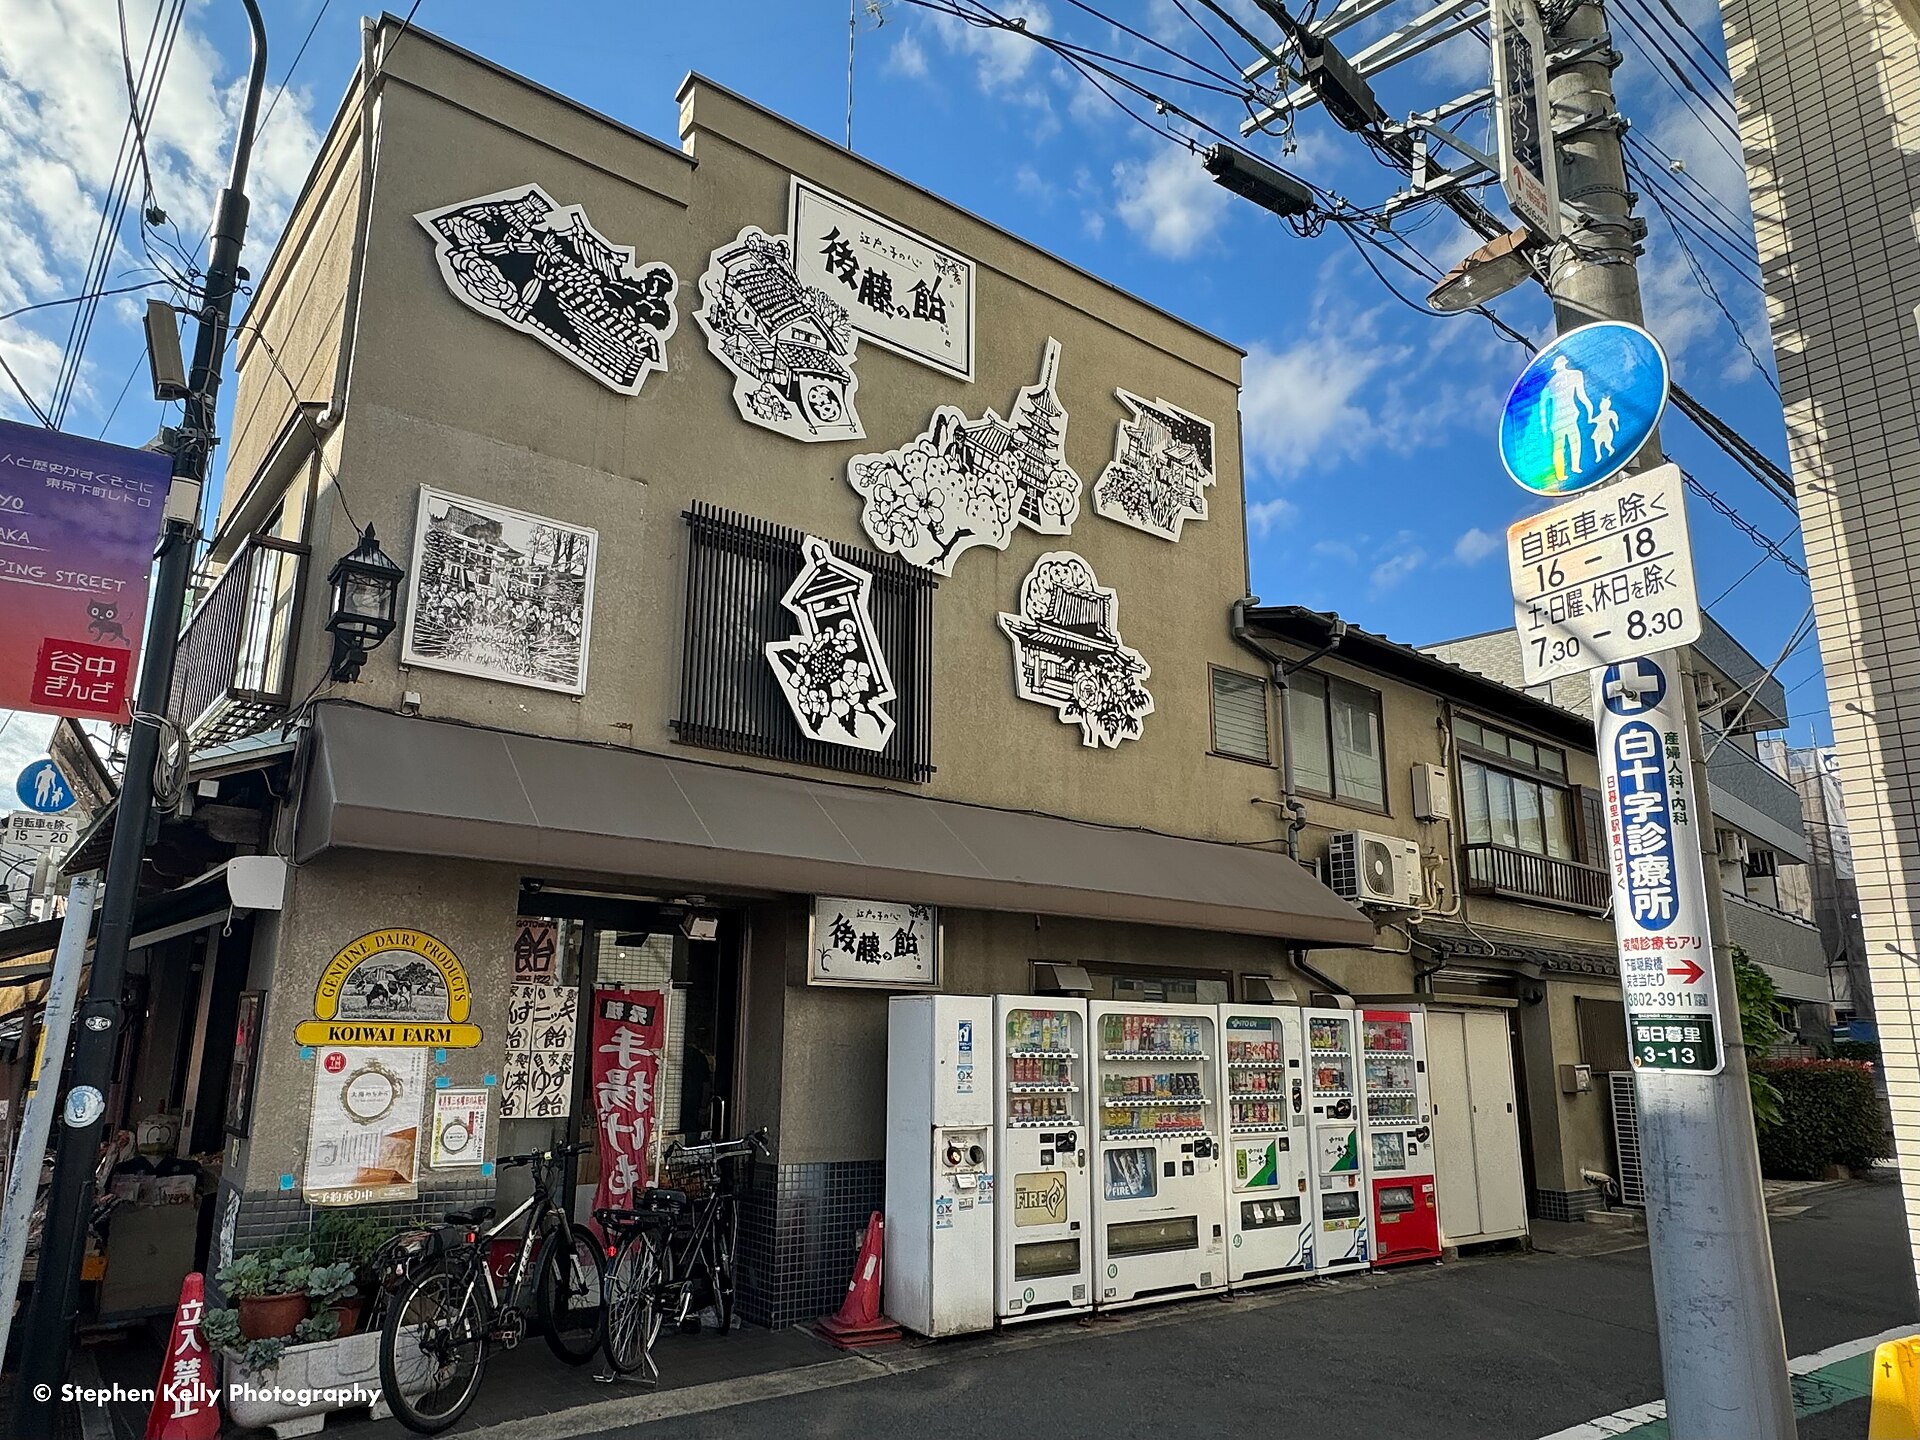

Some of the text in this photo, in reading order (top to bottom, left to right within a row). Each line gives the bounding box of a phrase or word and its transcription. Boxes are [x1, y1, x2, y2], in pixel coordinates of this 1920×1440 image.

[819, 226, 946, 325] 後藤の飴
[45, 477, 151, 508] 東京下町レトロ
[1521, 492, 1667, 561] 自転車を除く
[1537, 558, 1565, 591] 16
[1622, 527, 1656, 563] 18
[55, 570, 127, 593] STREET
[1531, 636, 1580, 668] 7.30
[1627, 608, 1684, 641] 8.30
[50, 651, 116, 677] 谷中
[44, 675, 115, 703] ぎんざ
[1664, 731, 1688, 826] 産婦人科・内科
[13, 817, 73, 831] 自転車を除く
[15, 830, 28, 841] 15
[50, 832, 69, 843] 20
[1607, 776, 1625, 890] 日暮里駅東口すぐ
[1618, 727, 1674, 921] 白十字診療所
[514, 927, 555, 973] 飴
[829, 912, 918, 965] 後藤の飴
[1623, 936, 1702, 952] 夜間診療もアリ
[322, 933, 466, 1002] GENUINE DAIRY PRODUCTS
[1628, 991, 1692, 1007] 3802-3911
[328, 1026, 451, 1042] KOIWAI FARM
[536, 1025, 567, 1048] 飴
[1636, 1026, 1702, 1043] 西日暮里
[1643, 1046, 1696, 1064] 3-13
[532, 1066, 570, 1099] ゆず
[531, 1093, 562, 1116] 飴
[1015, 1191, 1048, 1209] FIRE
[1112, 1185, 1131, 1196] FIRE
[171, 1299, 203, 1419] 立入禁止
